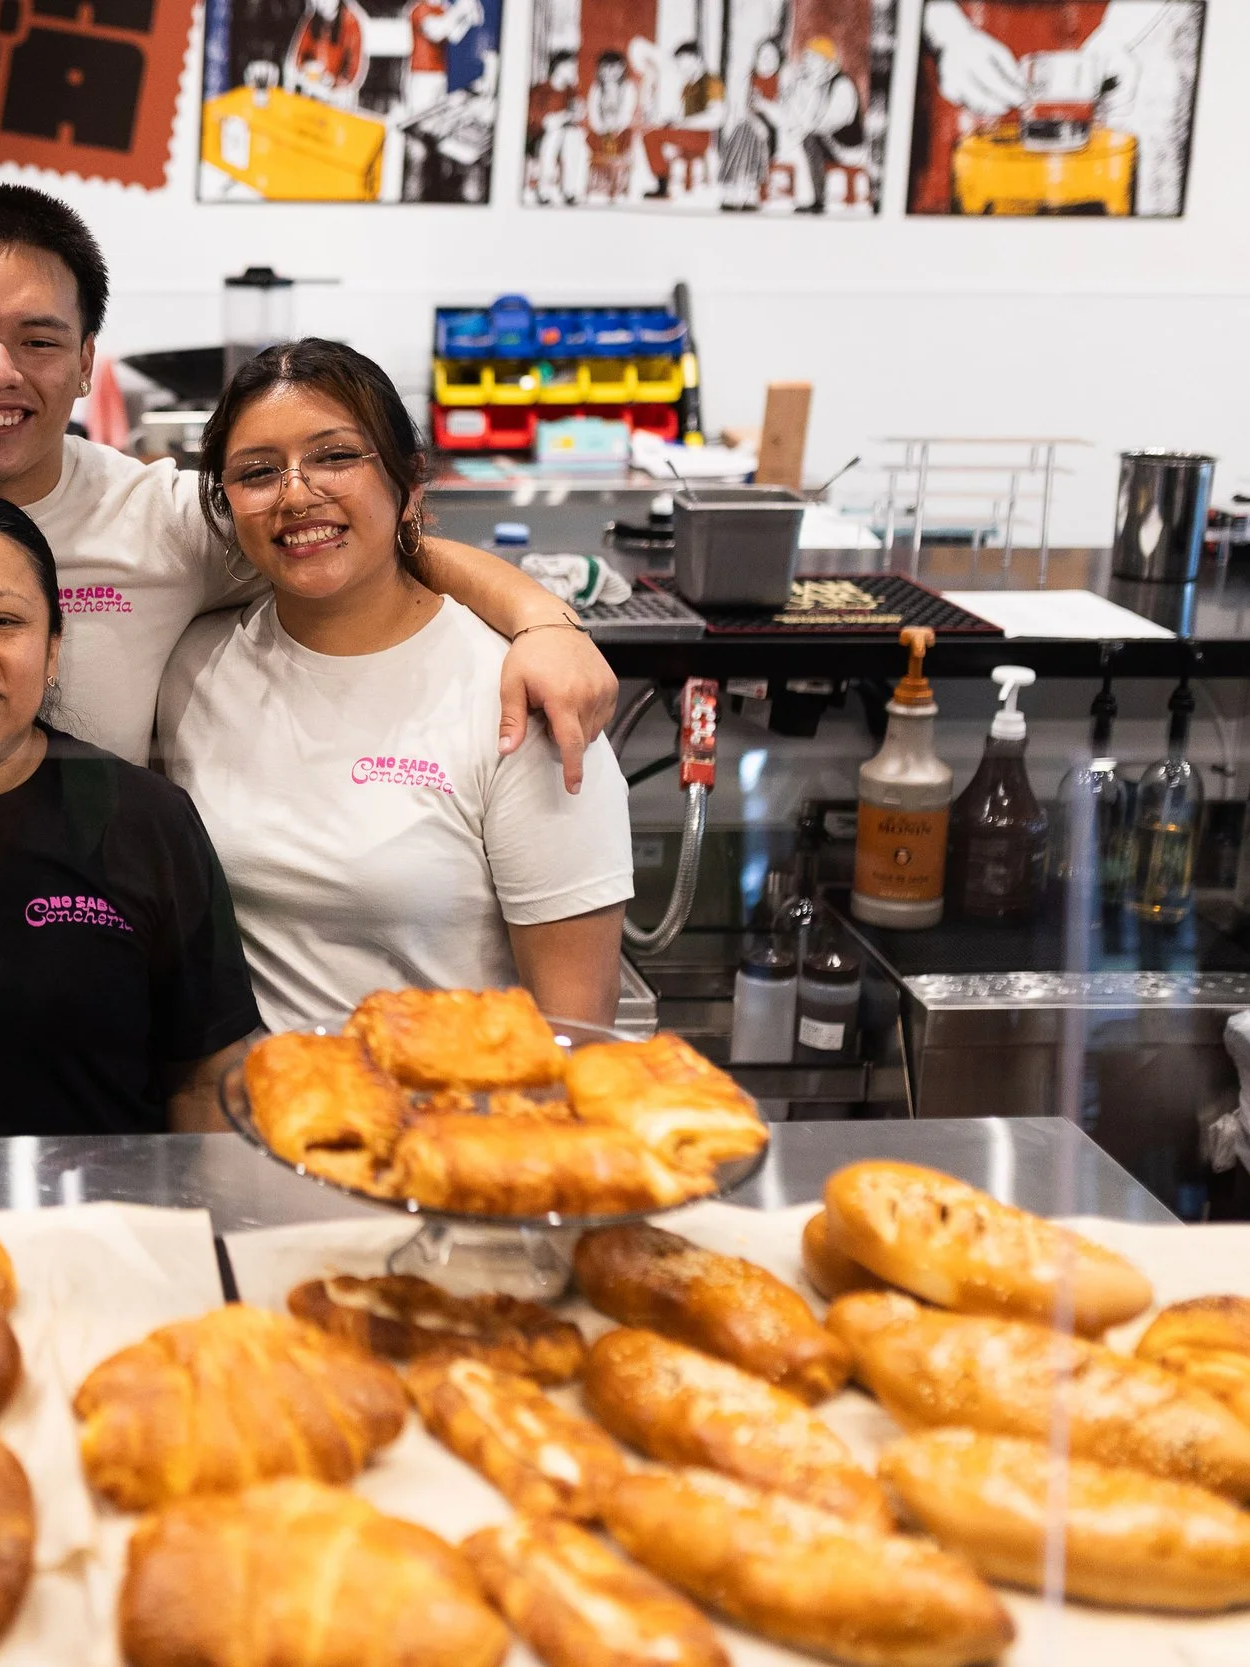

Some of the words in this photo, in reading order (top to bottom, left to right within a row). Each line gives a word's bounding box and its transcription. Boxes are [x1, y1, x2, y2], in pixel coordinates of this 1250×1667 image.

[59, 596, 133, 614] ncheria
[376, 756, 395, 768] NO
[351, 757, 454, 794] Concheria
[49, 896, 72, 908] NO
